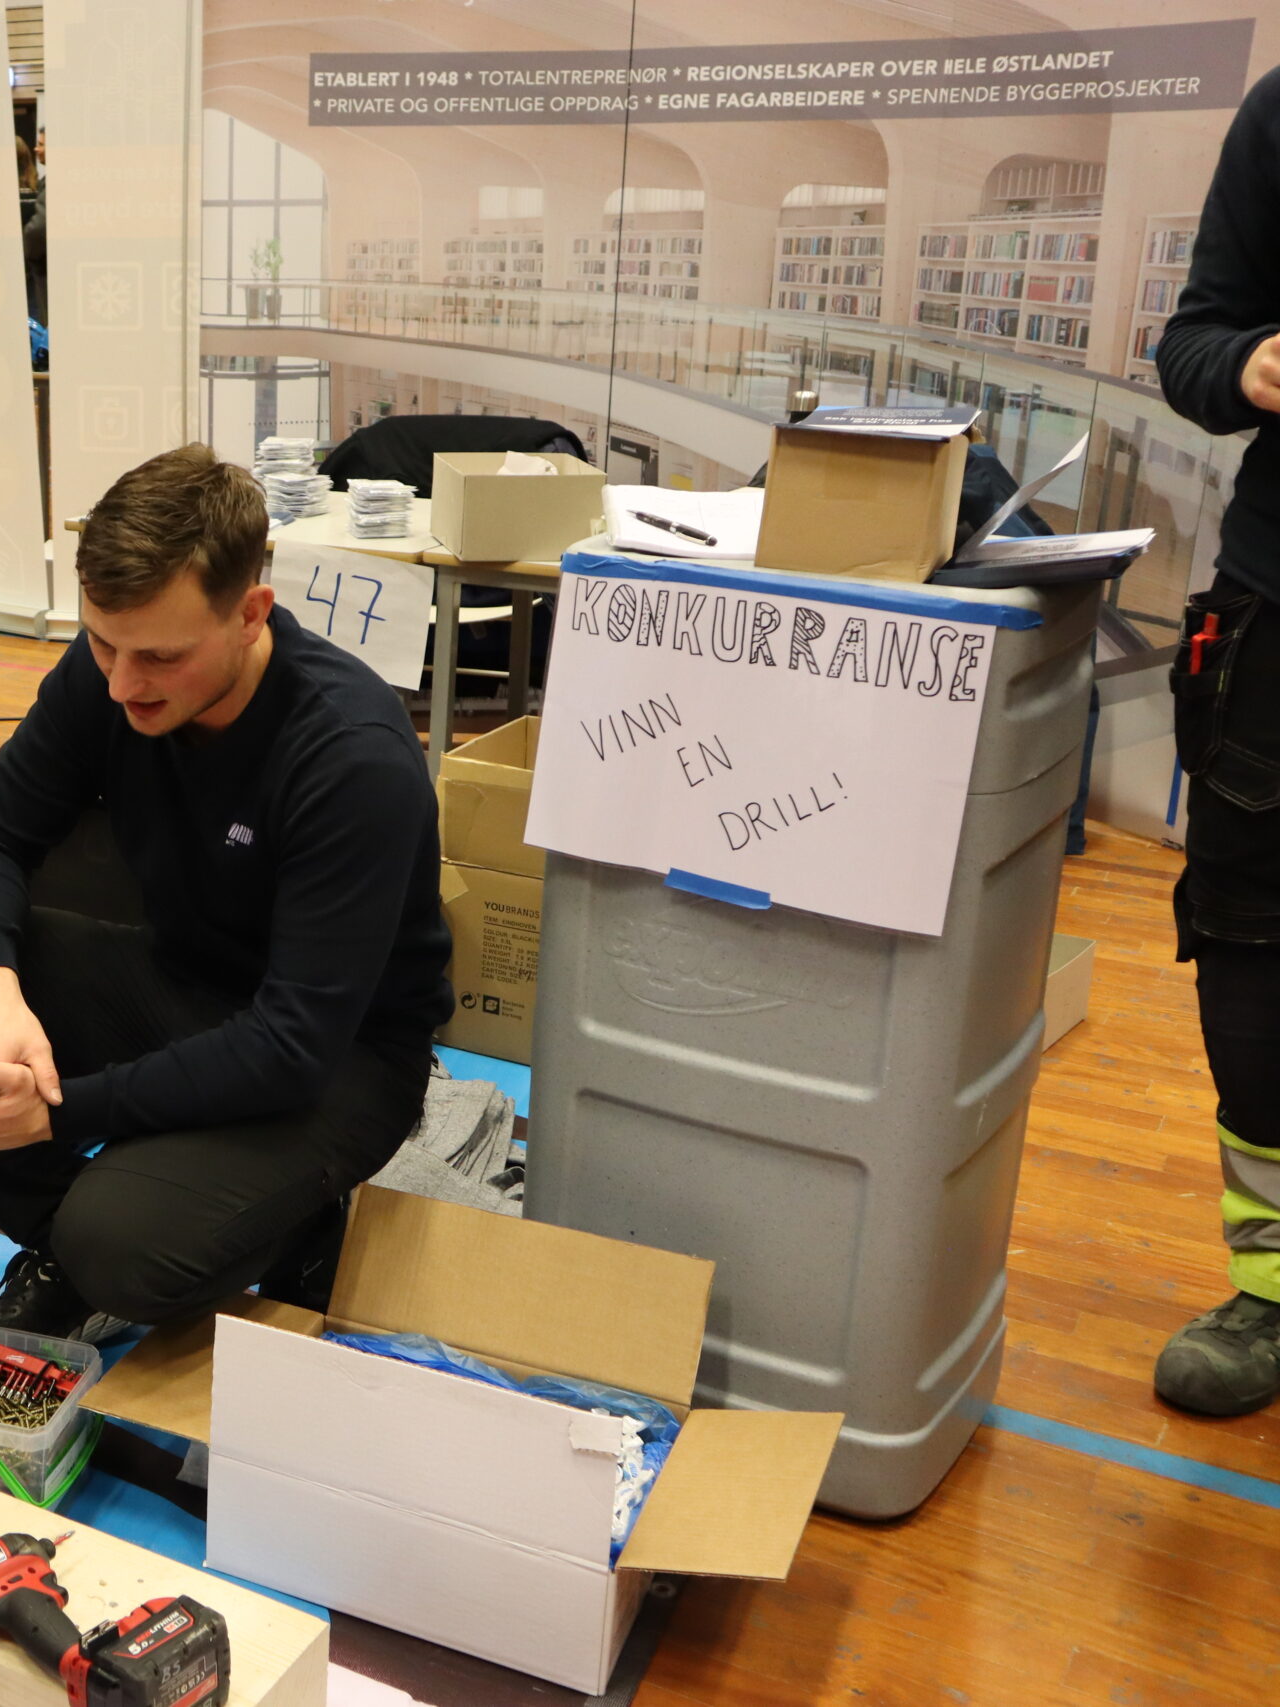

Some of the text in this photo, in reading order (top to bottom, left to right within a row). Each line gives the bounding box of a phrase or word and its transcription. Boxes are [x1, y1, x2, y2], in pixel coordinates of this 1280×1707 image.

[314, 50, 1114, 87] ETABLERT I 1948 TOTALENTREPRENØR REGIONSELSKAPER OVER HELE ØSTLANDET
[326, 76, 1201, 114] PRIVATE OG OFFENTLIGE OPPDRAG EGNE FAGARBEIDERE SPENNENDE BYGGEPROSJEKTER
[306, 565, 386, 645] 47
[571, 577, 986, 702] KONKURRANSE
[580, 693, 682, 762] VINN
[676, 734, 733, 788] EN
[718, 772, 849, 851] DRILL!
[483, 901, 541, 919] YOUBRANDS
